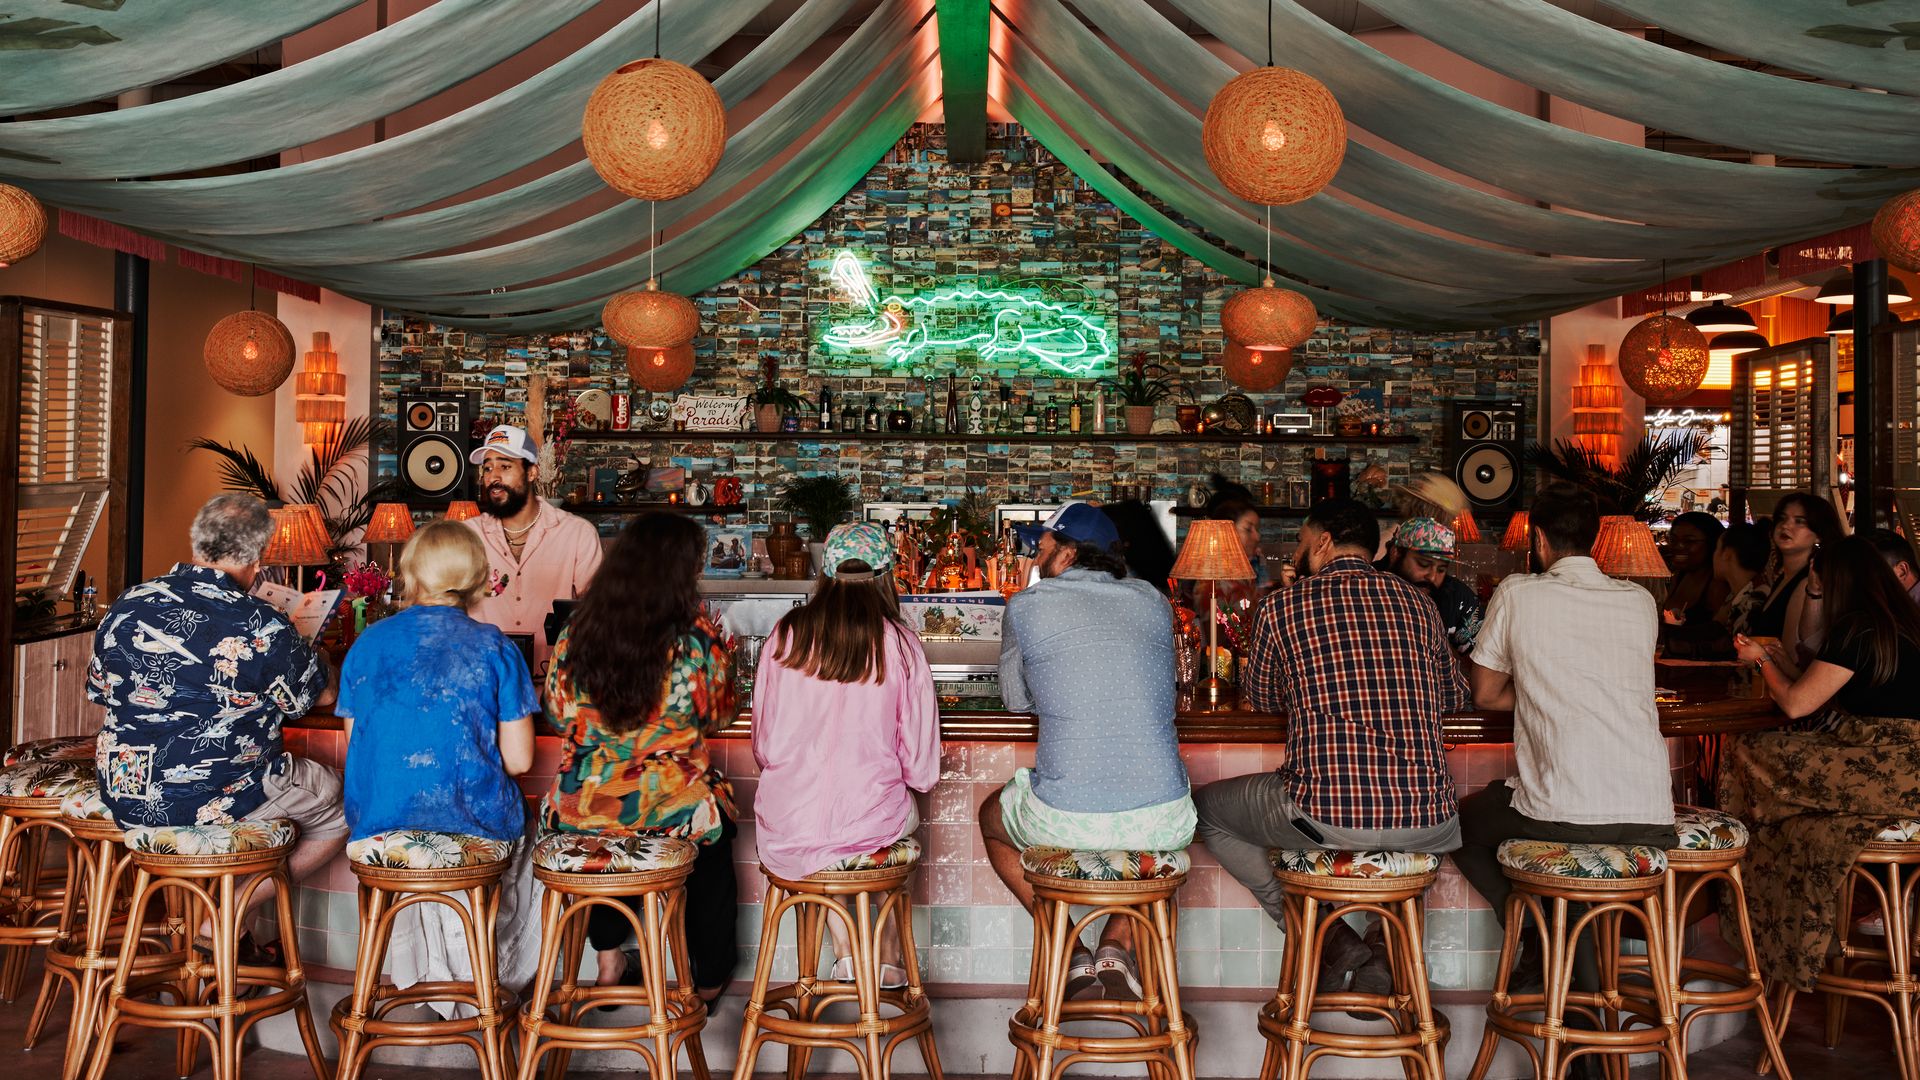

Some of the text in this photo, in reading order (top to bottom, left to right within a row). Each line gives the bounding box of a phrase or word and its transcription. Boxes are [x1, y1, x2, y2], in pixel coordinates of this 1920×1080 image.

[616, 398, 627, 424] Coke
[685, 406, 738, 426] Paradis
[1654, 408, 1723, 426] Your Journey
